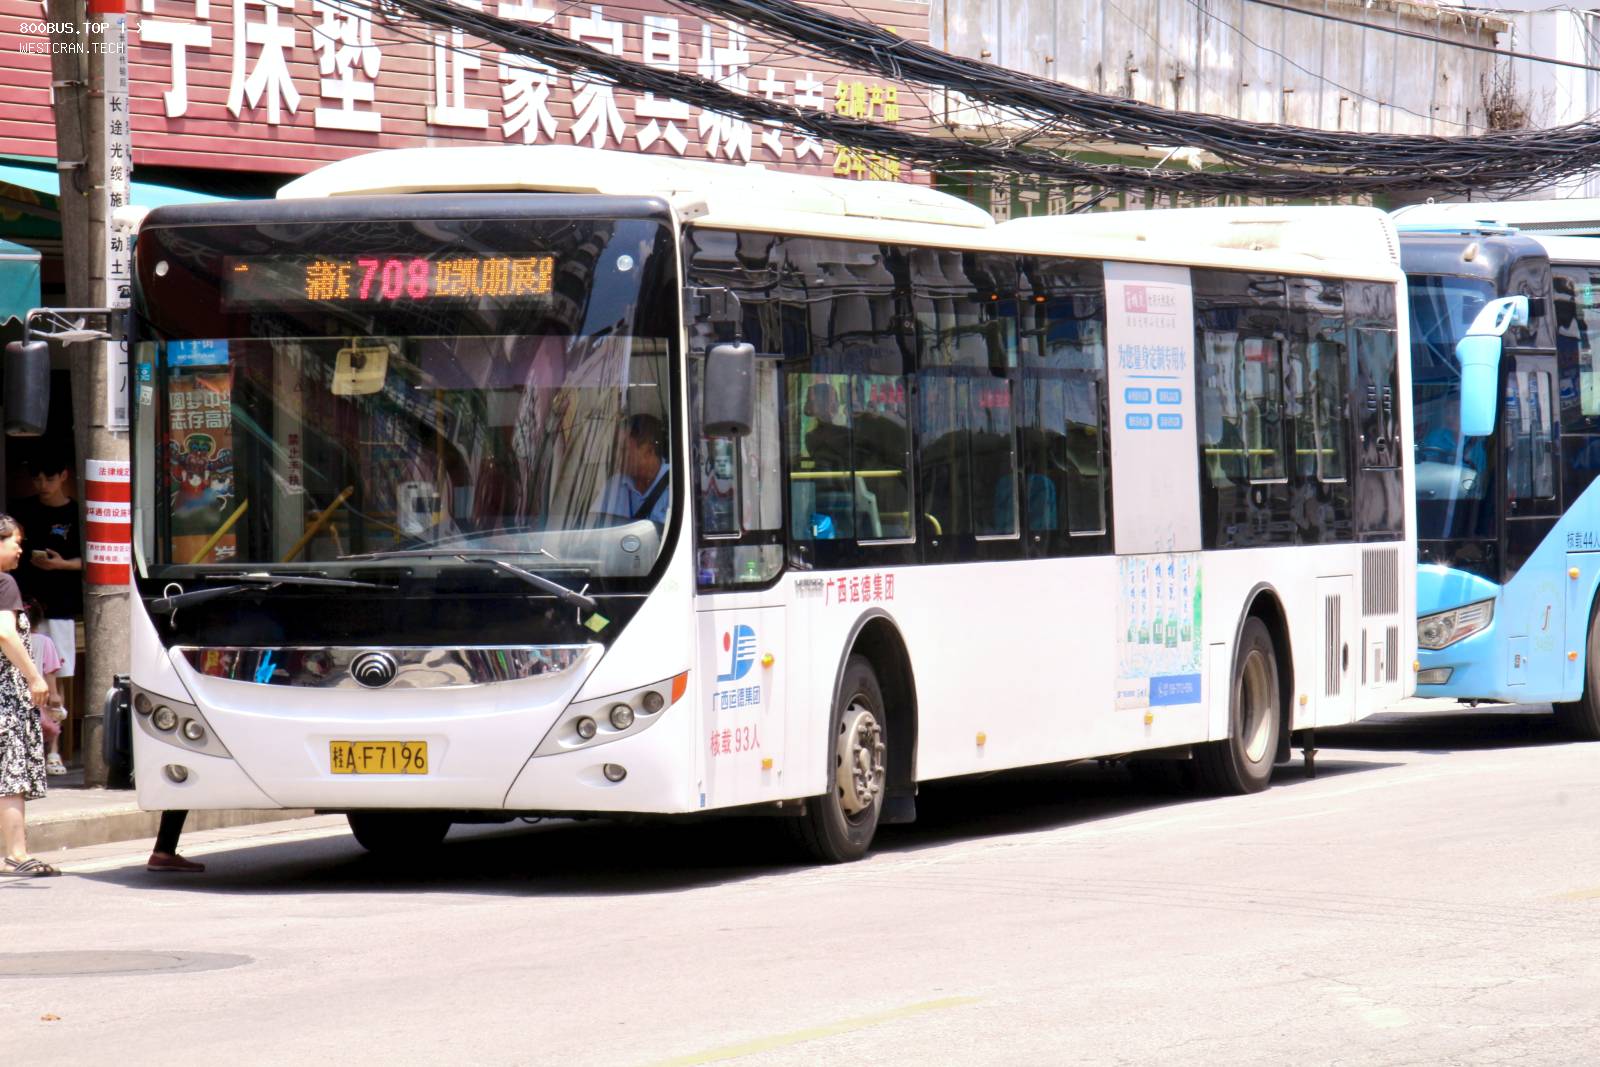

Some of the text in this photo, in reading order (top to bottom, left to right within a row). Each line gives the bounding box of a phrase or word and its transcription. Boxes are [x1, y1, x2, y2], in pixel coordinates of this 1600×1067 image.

[109, 96, 124, 275] 长途光缆施动土
[357, 257, 430, 300] 708
[825, 573, 896, 607] 广西运德集团
[712, 685, 761, 712] 广西运德集团
